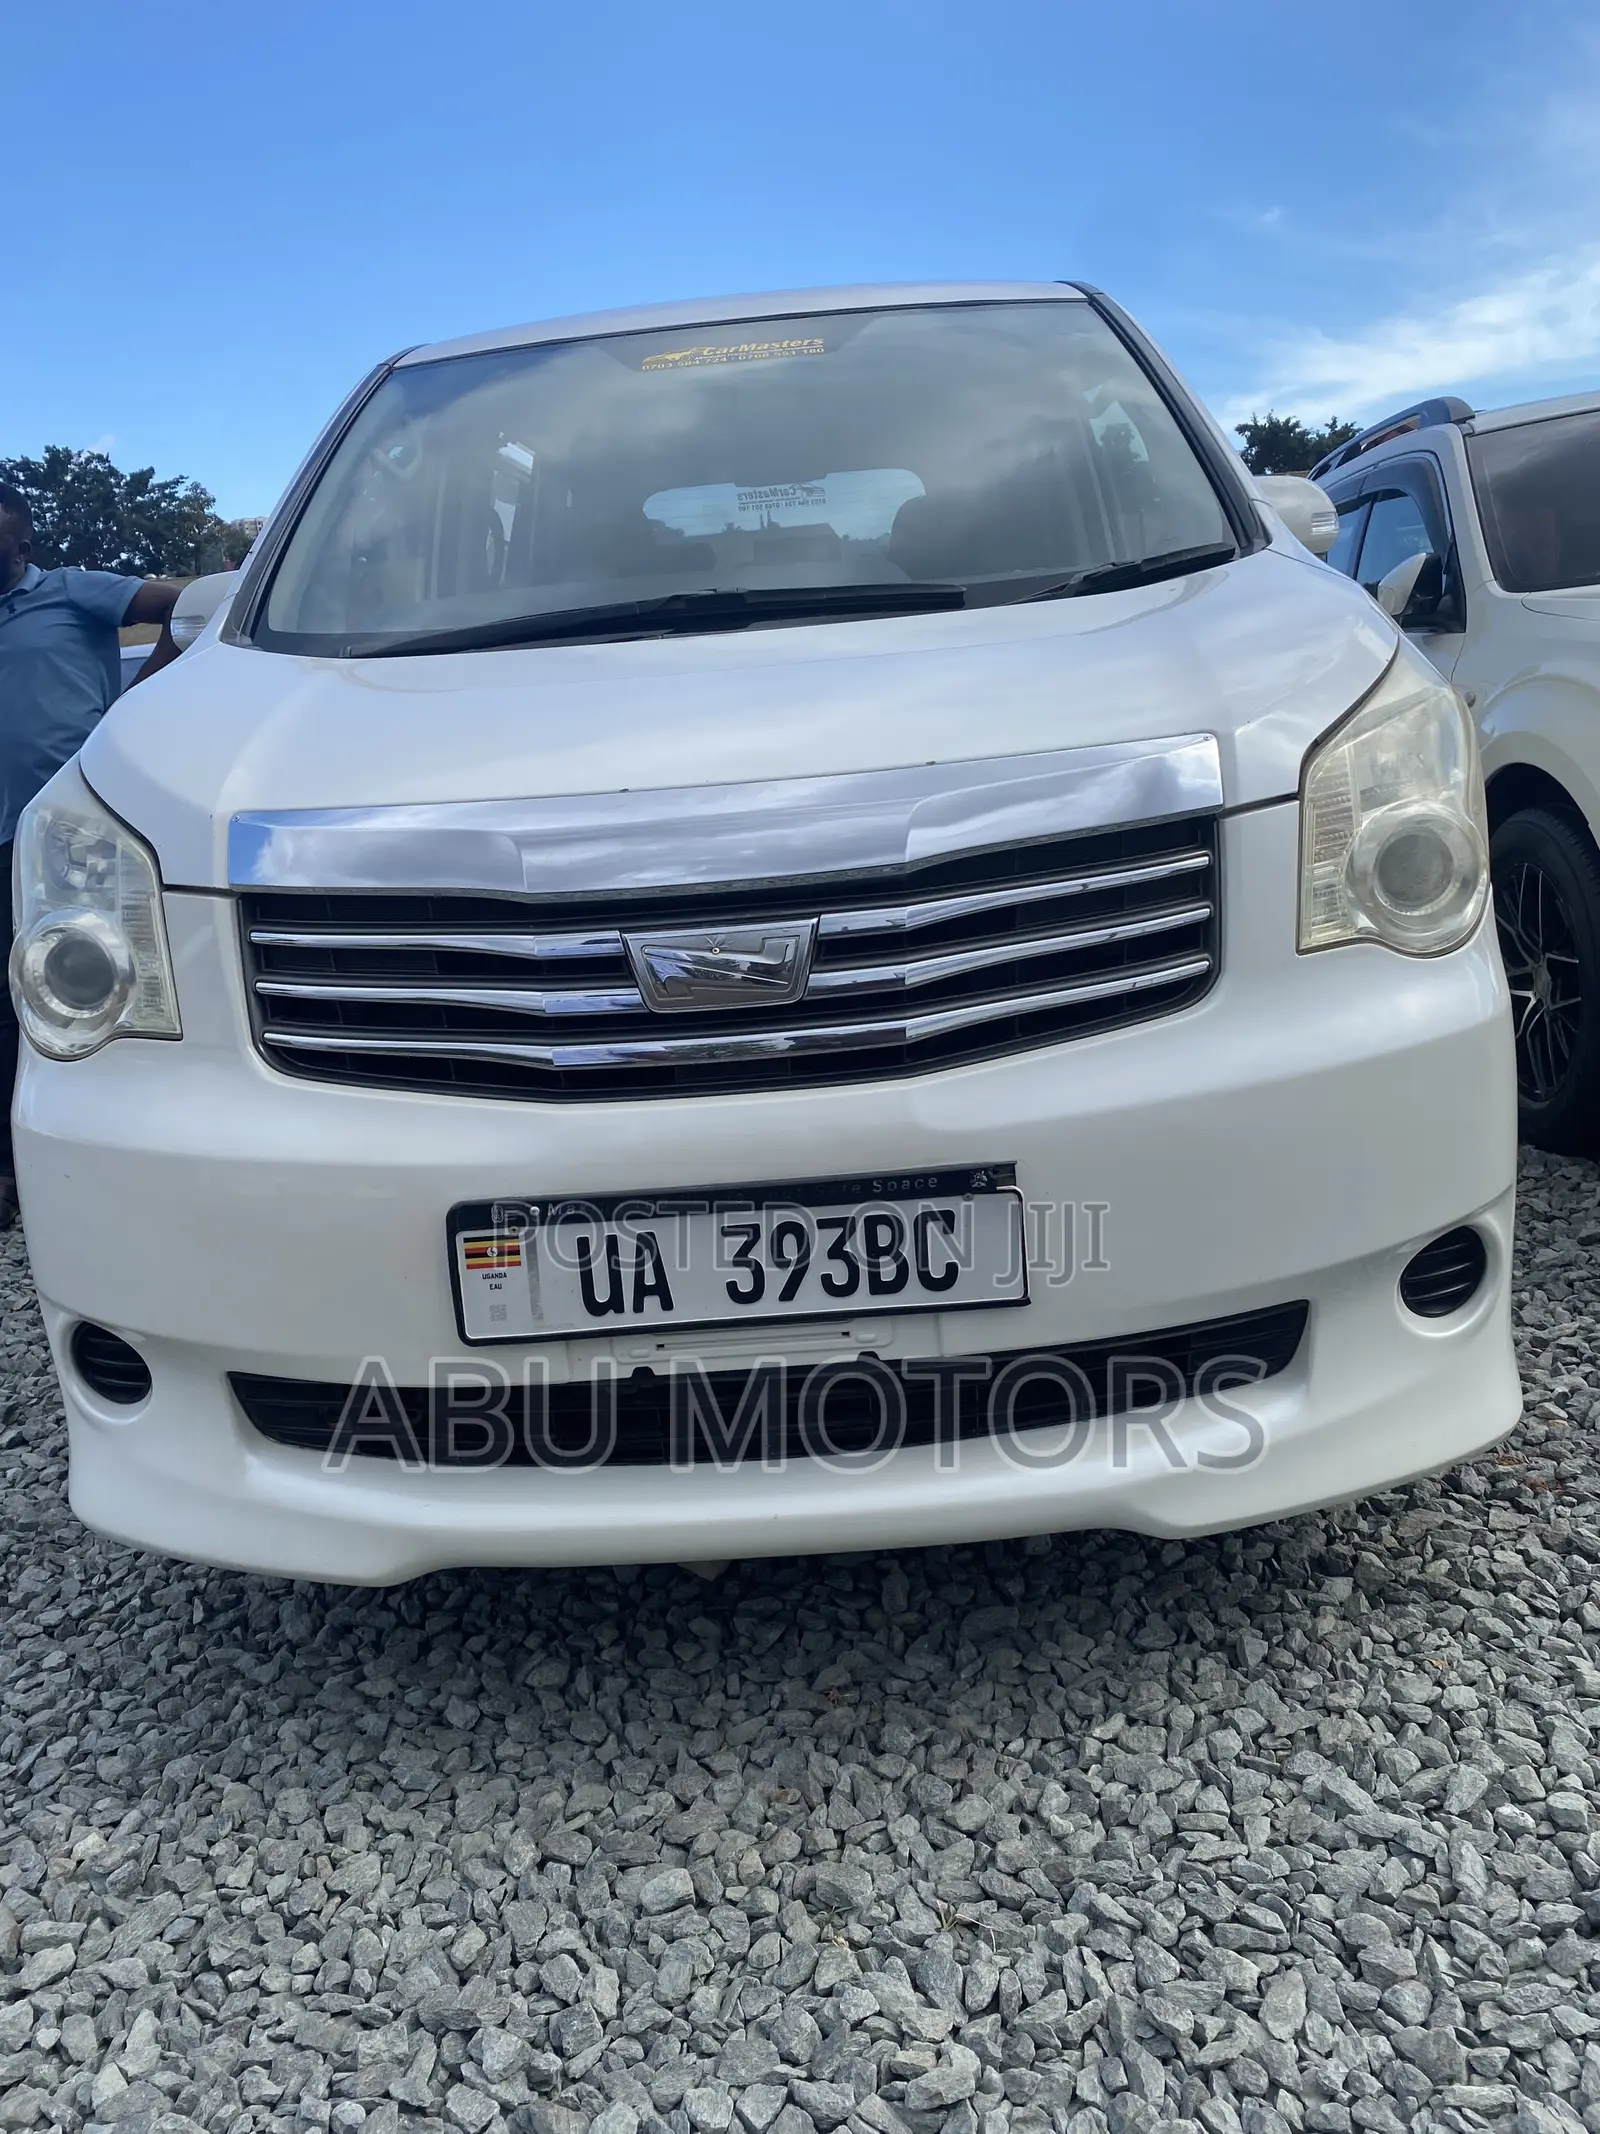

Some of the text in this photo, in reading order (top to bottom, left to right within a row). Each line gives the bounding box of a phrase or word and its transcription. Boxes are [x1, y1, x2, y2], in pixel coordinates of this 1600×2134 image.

[701, 337, 824, 356] CarMasters
[871, 1176, 938, 1194] Space
[576, 1209, 961, 1317] UA 393BC
[481, 1272, 508, 1280] UGANDA
[489, 1283, 503, 1291] EAU
